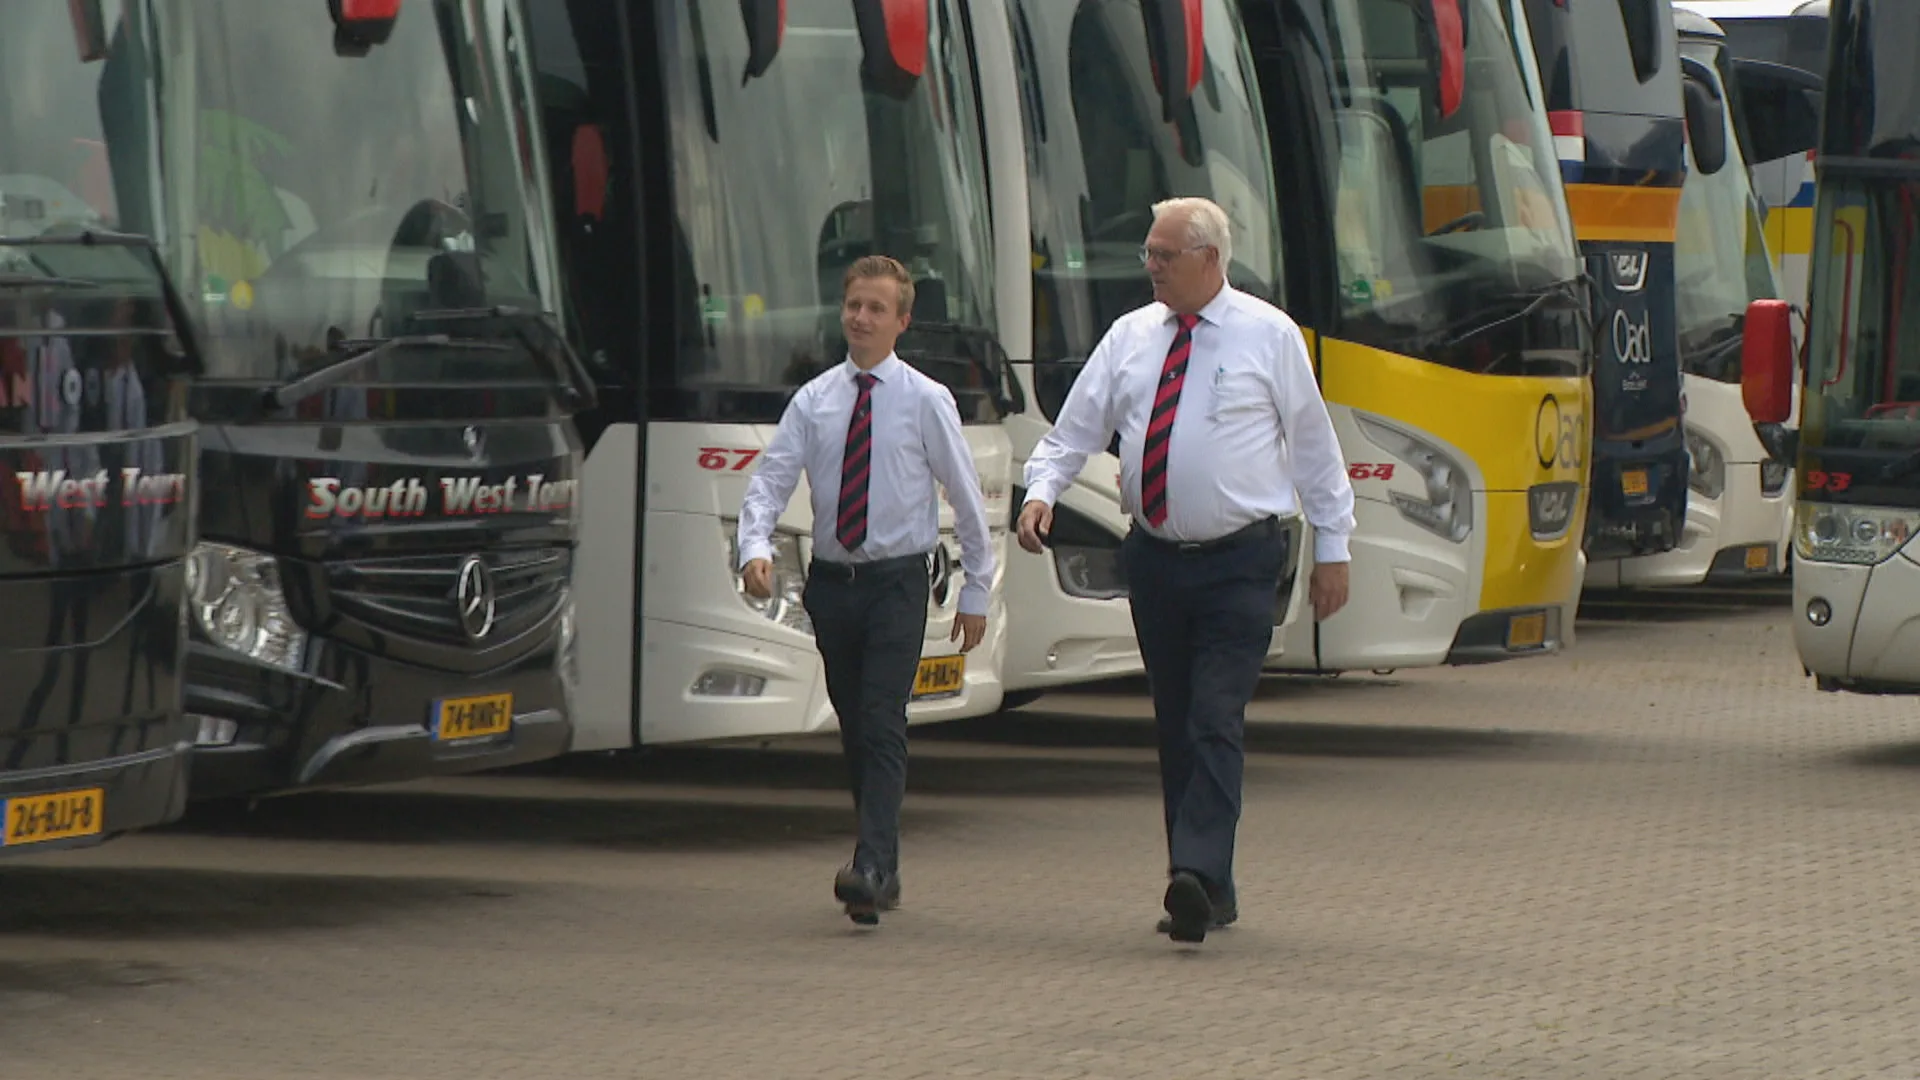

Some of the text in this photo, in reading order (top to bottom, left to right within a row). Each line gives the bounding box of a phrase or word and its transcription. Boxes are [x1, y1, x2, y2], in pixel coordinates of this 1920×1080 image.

[1612, 308, 1651, 364] Oad
[698, 447, 761, 471] 67
[1349, 463, 1396, 481] 64
[15, 468, 110, 512] West
[304, 476, 428, 519] South
[440, 474, 517, 515] West
[1807, 471, 1853, 492] 93
